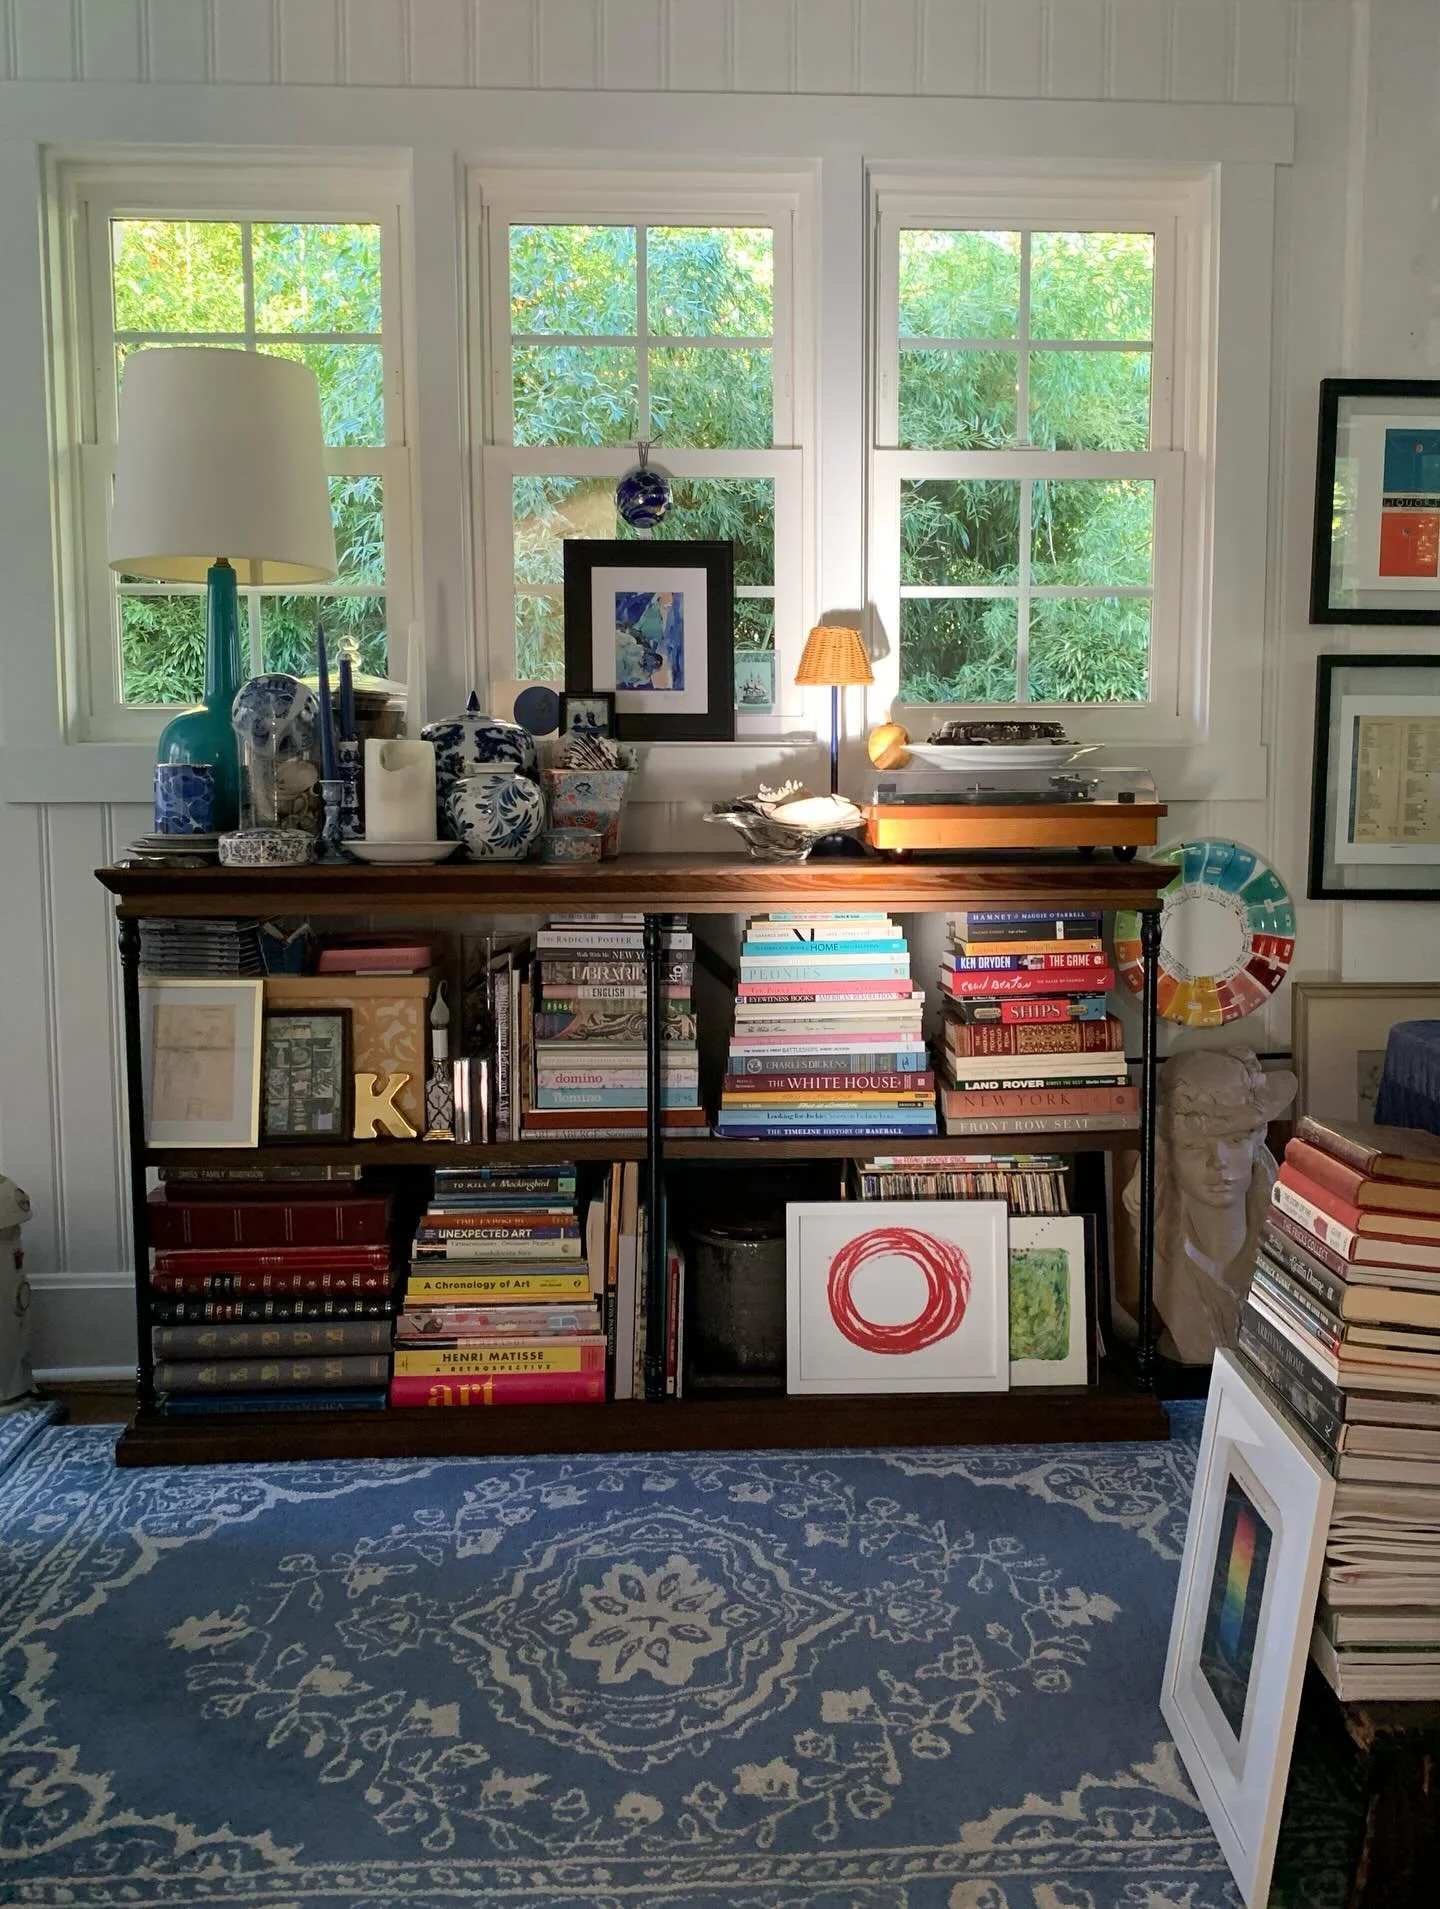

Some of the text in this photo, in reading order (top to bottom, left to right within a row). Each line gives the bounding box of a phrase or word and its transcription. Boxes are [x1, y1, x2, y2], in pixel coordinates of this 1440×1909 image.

[973, 913, 1011, 921] HAMNET
[556, 936, 594, 944] RADICAL
[598, 936, 632, 944] POTTER
[810, 943, 839, 952] HOME
[612, 951, 633, 960] NEW
[1050, 954, 1090, 967] THE GAME
[960, 954, 1011, 970] KEN DRYDEN
[592, 988, 625, 997] ENGLISH
[1010, 1004, 1061, 1019] SHIPS
[555, 1074, 603, 1084] domino
[768, 1080, 784, 1088] THE
[787, 1077, 840, 1089] WHITE
[845, 1076, 898, 1089] HOUSE
[965, 1082, 999, 1090] LAND
[1002, 1080, 1044, 1089] ROVER
[964, 1092, 1072, 1107] NEW YORK
[354, 1073, 416, 1138] K
[960, 1118, 1090, 1133] FRONT ROW SEAT
[499, 1179, 550, 1191] Mockingbird
[439, 1228, 532, 1239] UNEXPECTED ART
[435, 1281, 496, 1290] Chronology
[500, 1280, 510, 1288] of
[514, 1280, 530, 1288] Art
[442, 1351, 544, 1362] HENRI MATISSE
[450, 1364, 551, 1372] RETROSPECTIVE
[427, 1376, 496, 1407] art
